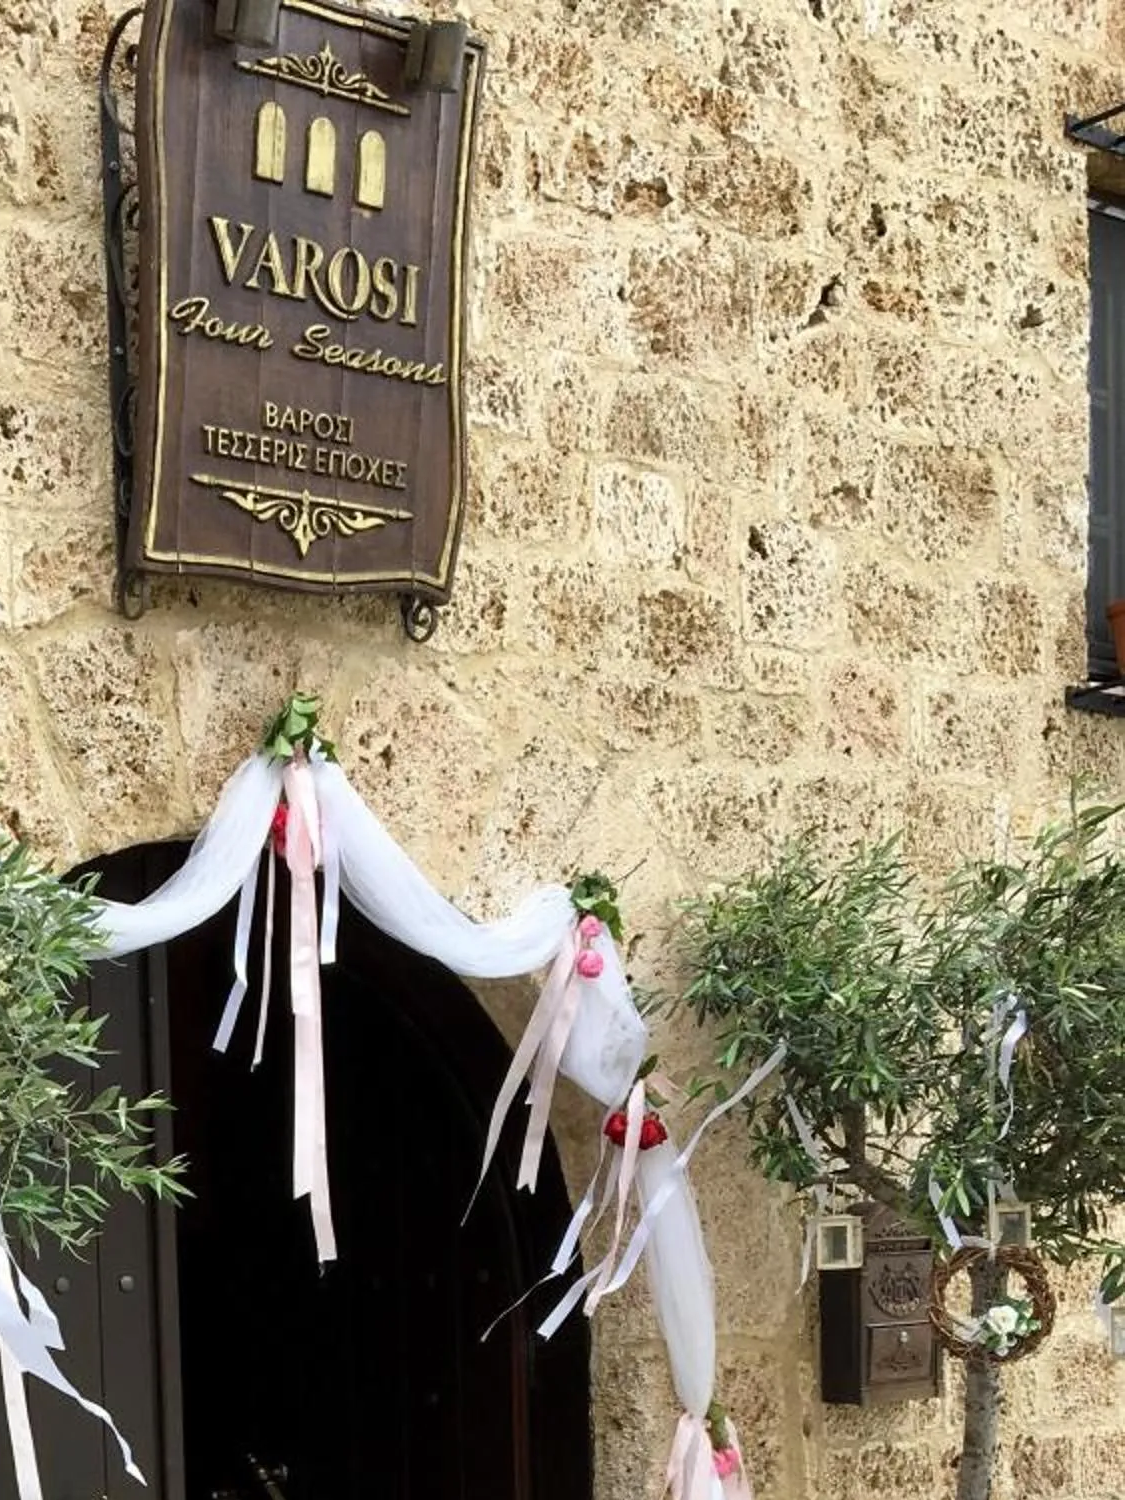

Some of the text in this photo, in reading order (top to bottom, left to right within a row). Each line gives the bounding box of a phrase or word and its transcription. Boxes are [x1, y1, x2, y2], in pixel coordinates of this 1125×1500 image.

[210, 217, 420, 326] VAROSI
[170, 297, 446, 385] Four Seasons
[203, 425, 407, 488] ΤΕΣΣΕΡΙΣ ΕΠΟΧΕΣ
[266, 401, 354, 444] ΒΑΡΟΣΙ
